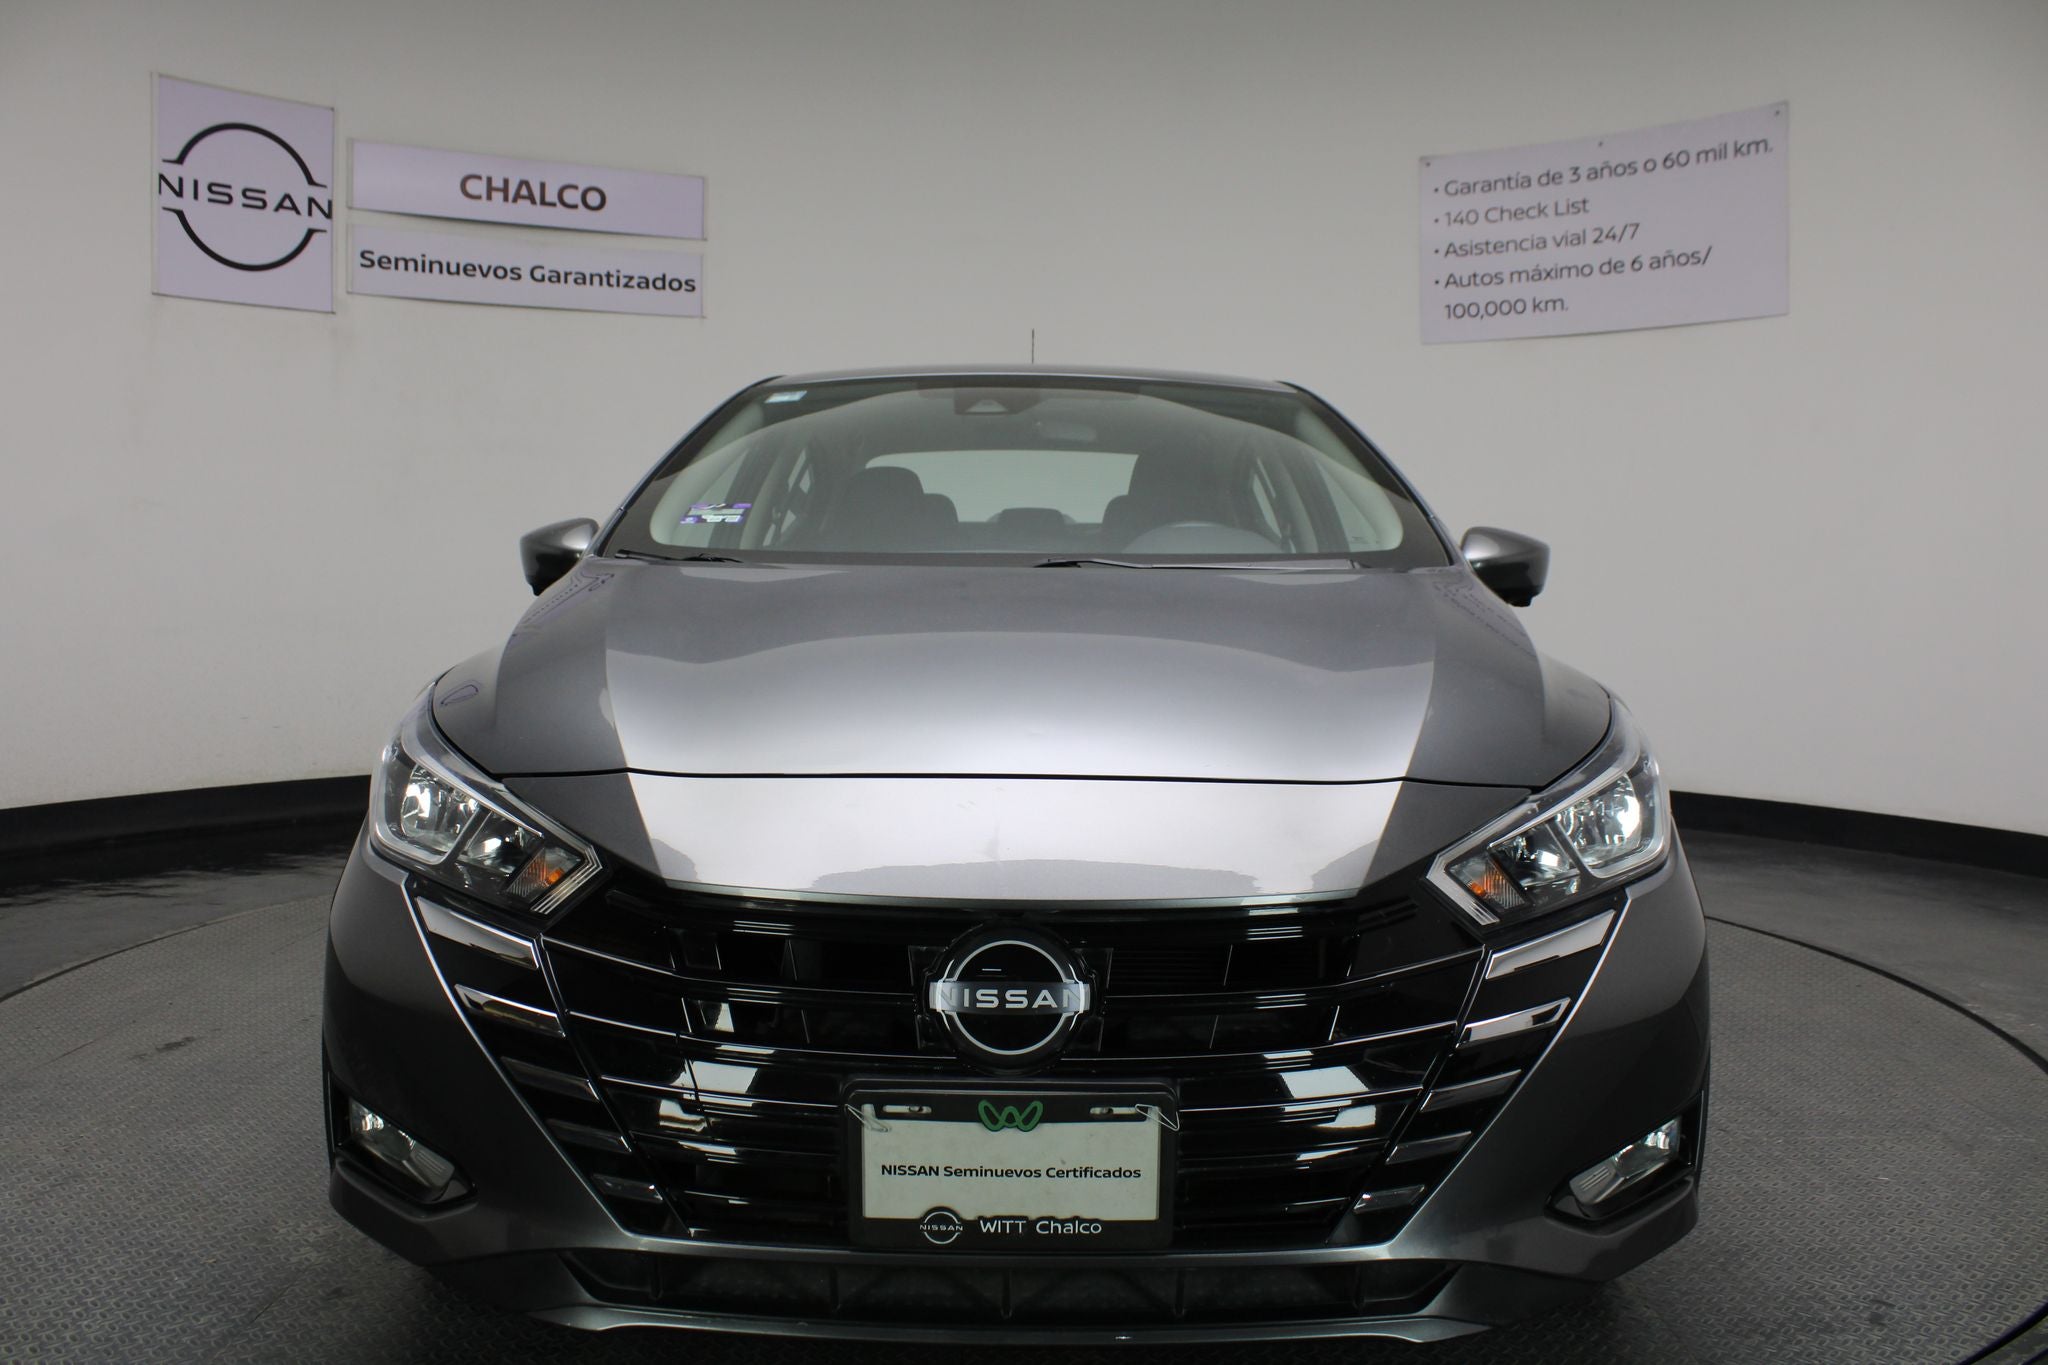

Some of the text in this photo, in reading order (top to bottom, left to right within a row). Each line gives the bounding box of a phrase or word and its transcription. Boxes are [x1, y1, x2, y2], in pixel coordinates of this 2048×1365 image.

[1444, 136, 1774, 197] Garantía de 3 años o 60 mil km.
[158, 172, 333, 220] NISSAN
[459, 173, 607, 212] CHALCO
[1445, 197, 1590, 227] 140 Check List
[1444, 222, 1641, 258] Asistencia vial 24/7
[358, 249, 697, 293] Seminuevos Garantizados
[1444, 246, 1713, 290] Autos máximo de 6 años/
[1445, 295, 1570, 321] 100,000 km.
[881, 1164, 1142, 1180] NISSAN Seminuevos Certificados
[919, 1224, 964, 1232] NISSAN
[980, 1219, 1102, 1235] WITT Chalco
